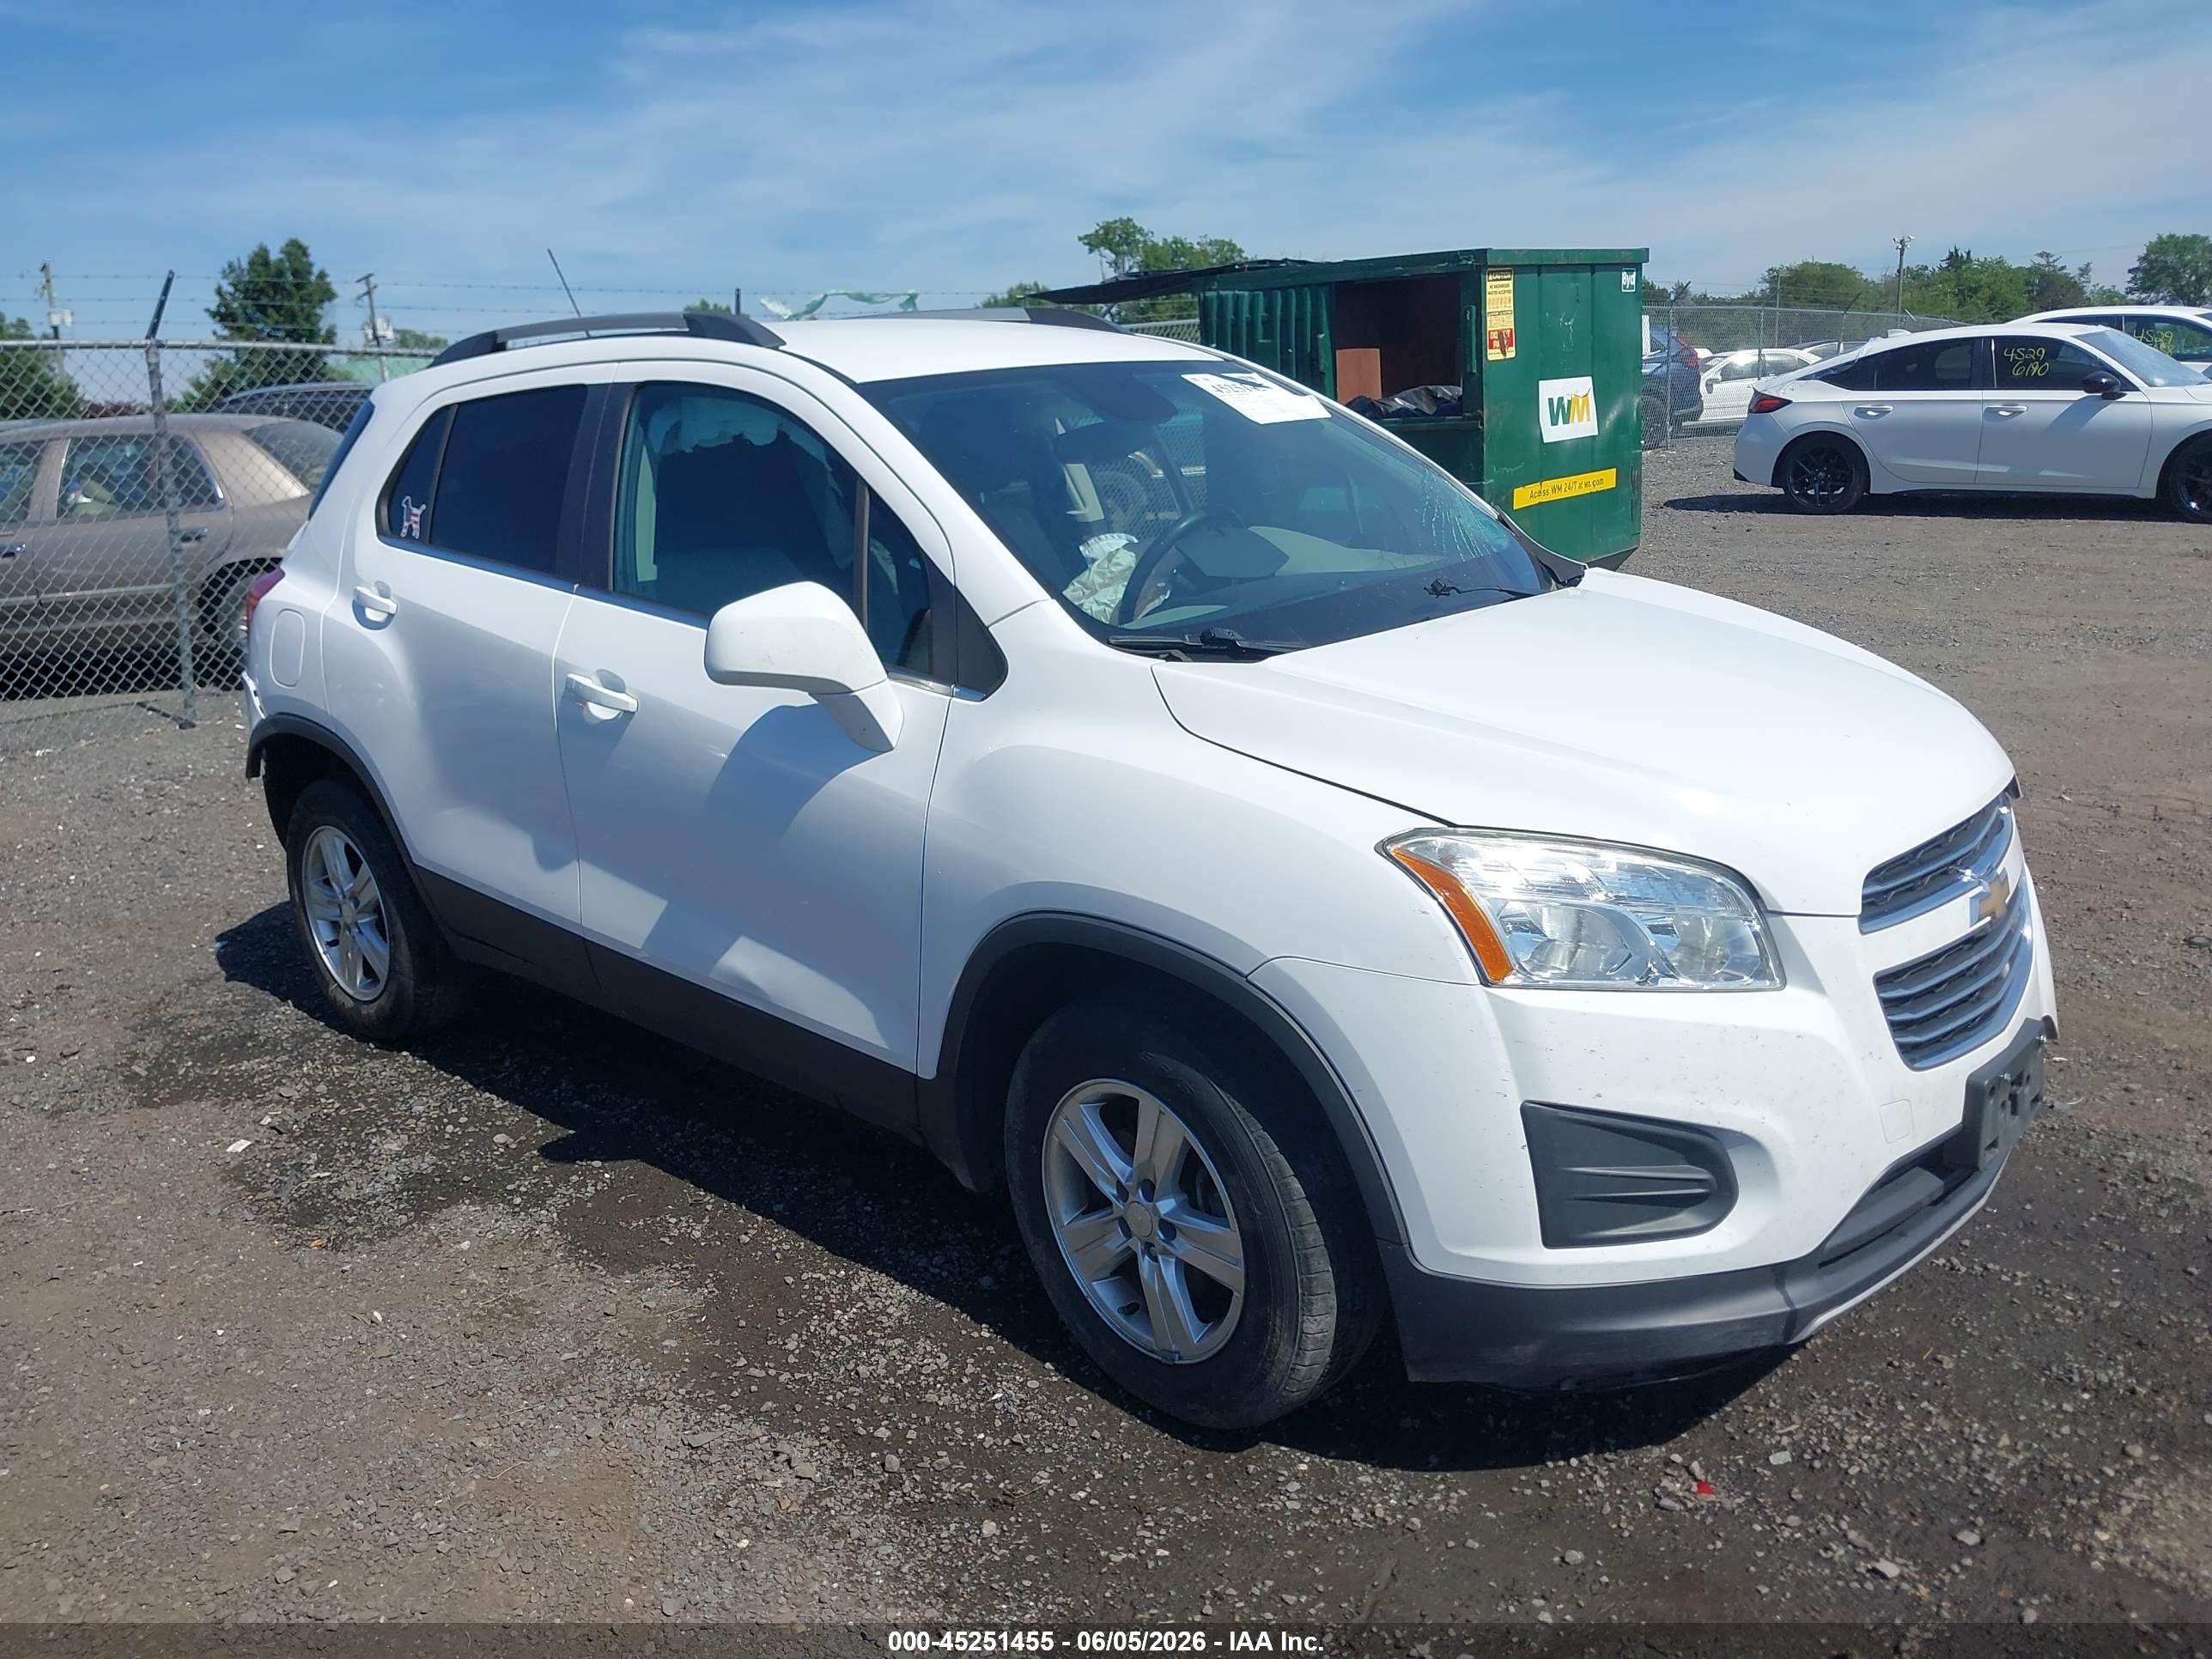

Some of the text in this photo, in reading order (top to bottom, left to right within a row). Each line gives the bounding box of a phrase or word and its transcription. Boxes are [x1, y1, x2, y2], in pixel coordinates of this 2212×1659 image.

[2133, 329, 2173, 344] 4529
[2003, 347, 2045, 362] 4529
[1547, 394, 1591, 426] WM
[1551, 483, 1563, 495] WM
[1564, 481, 1578, 493] 24/7
